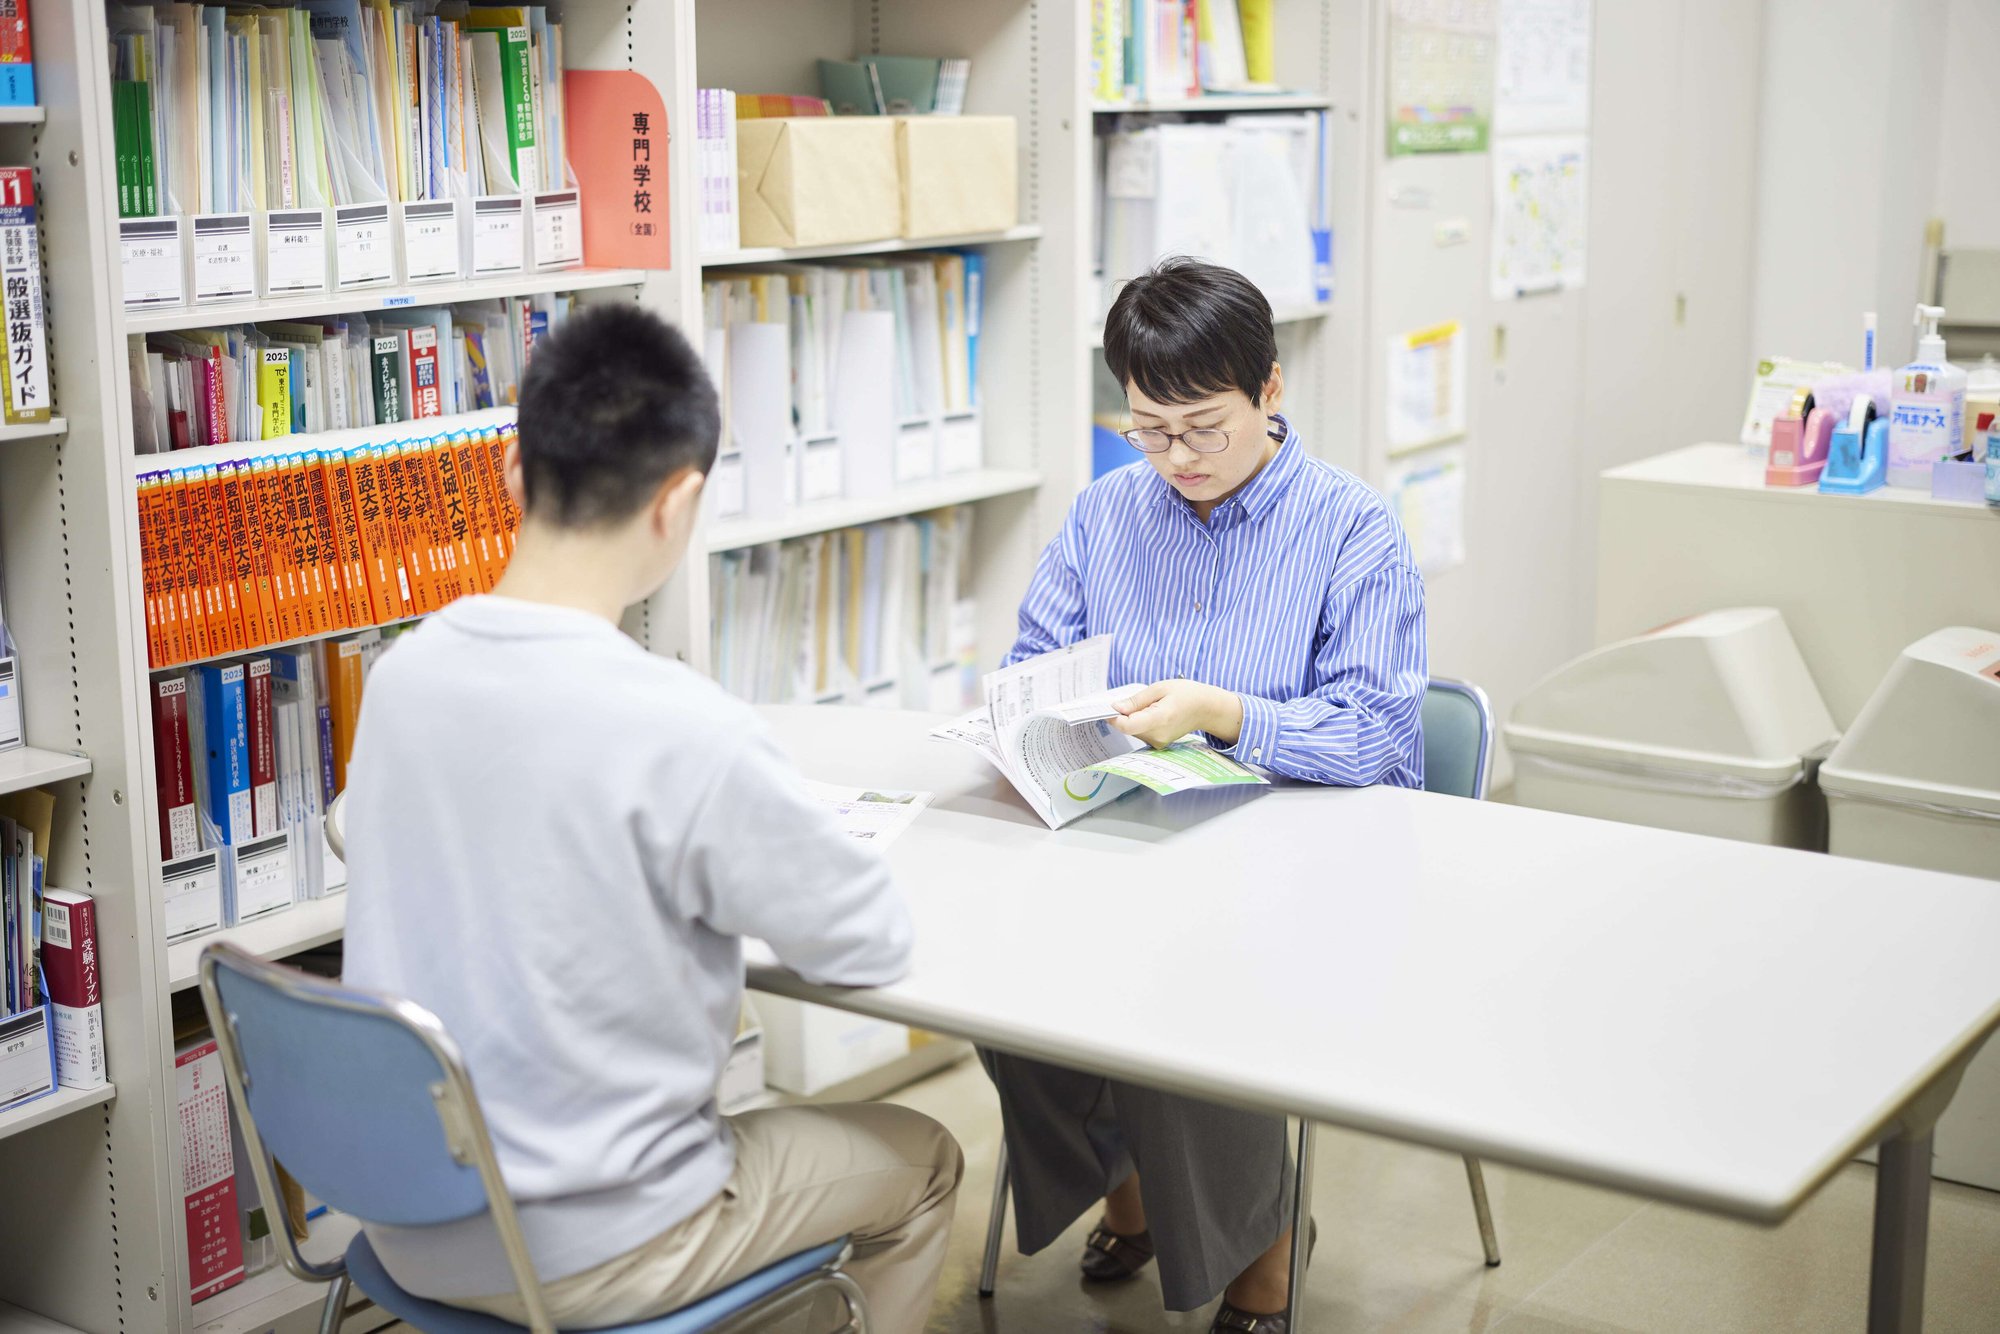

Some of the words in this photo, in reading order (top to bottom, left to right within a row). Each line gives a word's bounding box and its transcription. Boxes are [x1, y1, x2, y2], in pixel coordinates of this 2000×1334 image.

[510, 30, 527, 39] 2025
[632, 112, 651, 214] 専門学校
[14, 229, 24, 265] 全国大学
[284, 235, 310, 244] 歯科衛生
[265, 353, 288, 361] 2025
[377, 340, 398, 351] 2025
[257, 478, 274, 537] 中央大学
[267, 475, 287, 539] 中央大学
[335, 467, 357, 537] 東京都立大学
[356, 463, 380, 522] 法政大学
[375, 463, 394, 520] 法政大学
[388, 459, 412, 521] 東洋大学
[405, 457, 427, 519] 駒澤大学
[438, 451, 468, 541] 名城大学
[457, 447, 481, 510] 武庫川女子
[151, 493, 174, 594] 二松学舎大学
[165, 492, 185, 591] 千葉工業大学
[197, 486, 214, 547] 日本大学
[210, 484, 229, 556] 明治大学
[224, 481, 252, 579] 愛知淑徳大学
[242, 480, 263, 552] 青山学院大学
[281, 474, 305, 569] 拓殖大学
[294, 472, 319, 567] 武蔵大学
[309, 469, 336, 564] 国際医療福祉大学
[161, 682, 185, 694] 2025
[224, 669, 243, 681] 2025
[252, 662, 271, 674] 2025
[184, 880, 197, 891] 音楽
[81, 938, 97, 1005] 受験バイブル
[200, 1202, 221, 1216] スポーツ
